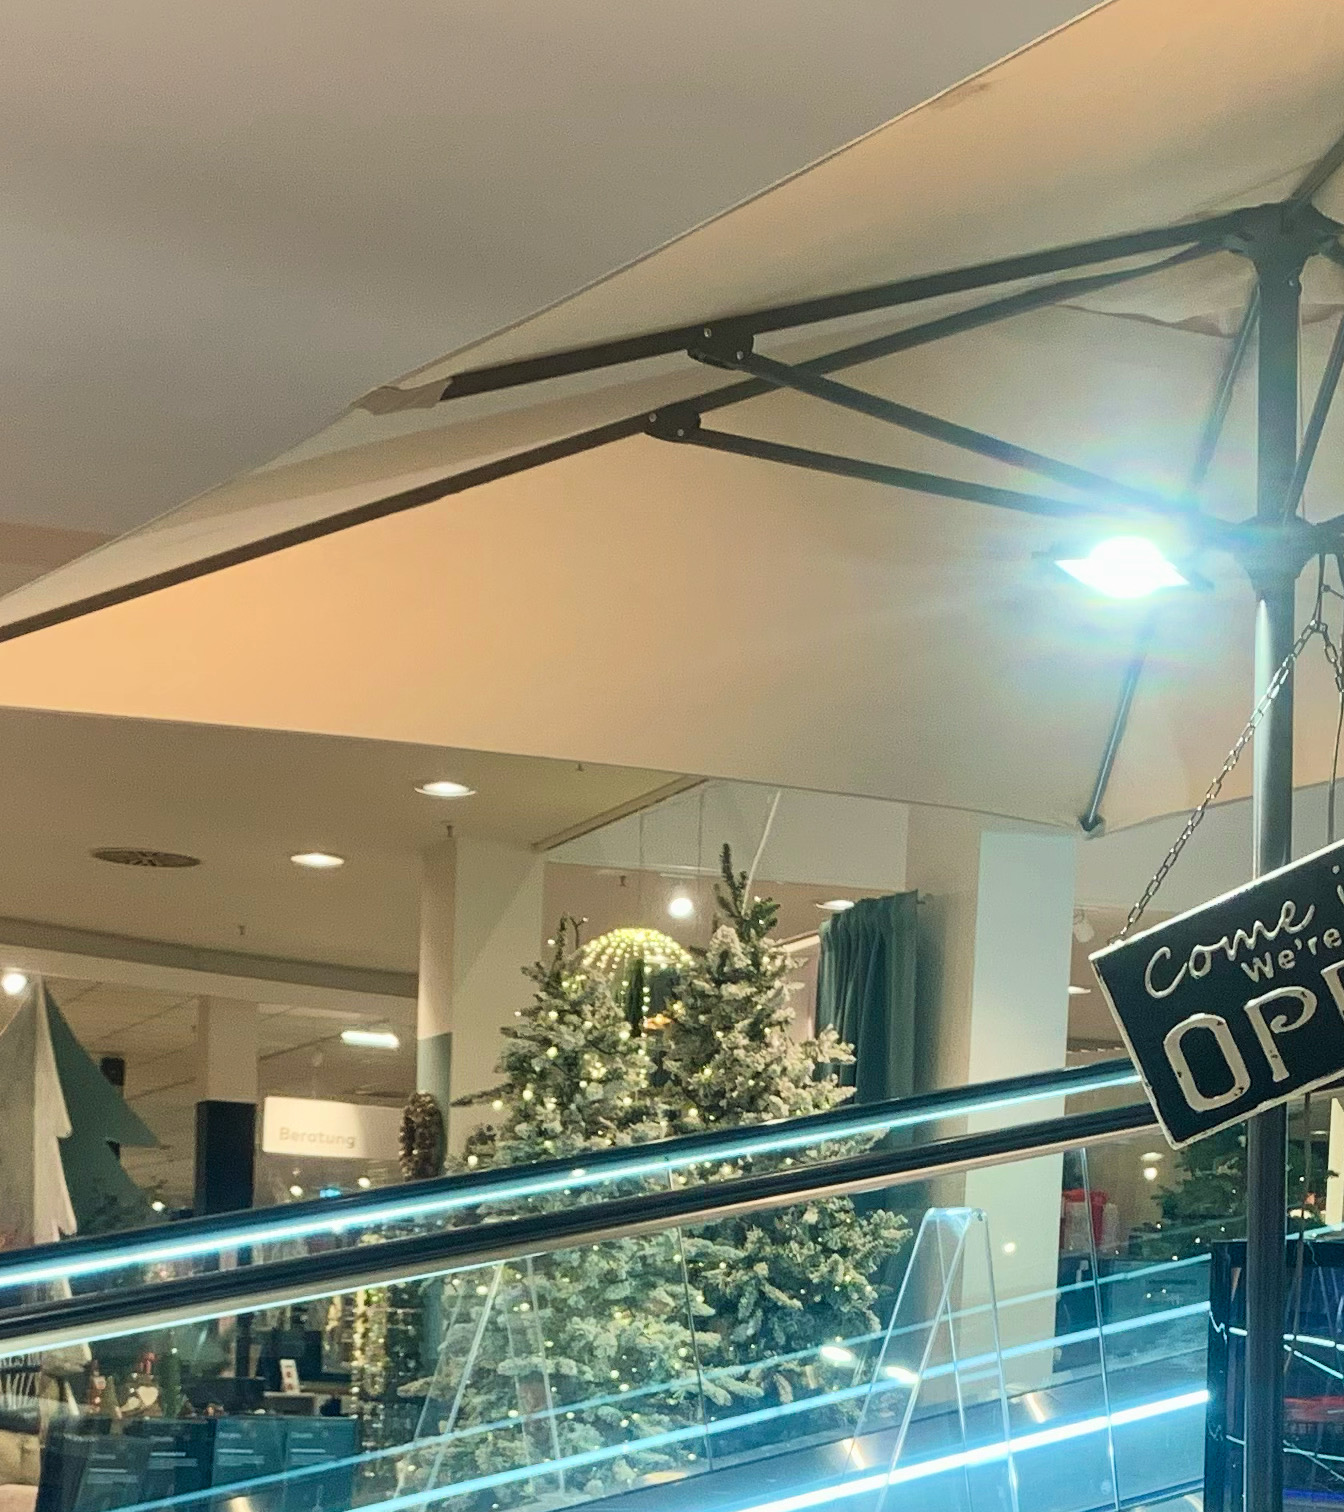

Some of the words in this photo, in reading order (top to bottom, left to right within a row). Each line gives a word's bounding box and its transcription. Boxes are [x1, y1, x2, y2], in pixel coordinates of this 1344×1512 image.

[1145, 901, 1315, 999] Come
[1242, 928, 1343, 983] We're
[279, 1127, 356, 1148] Beratung
